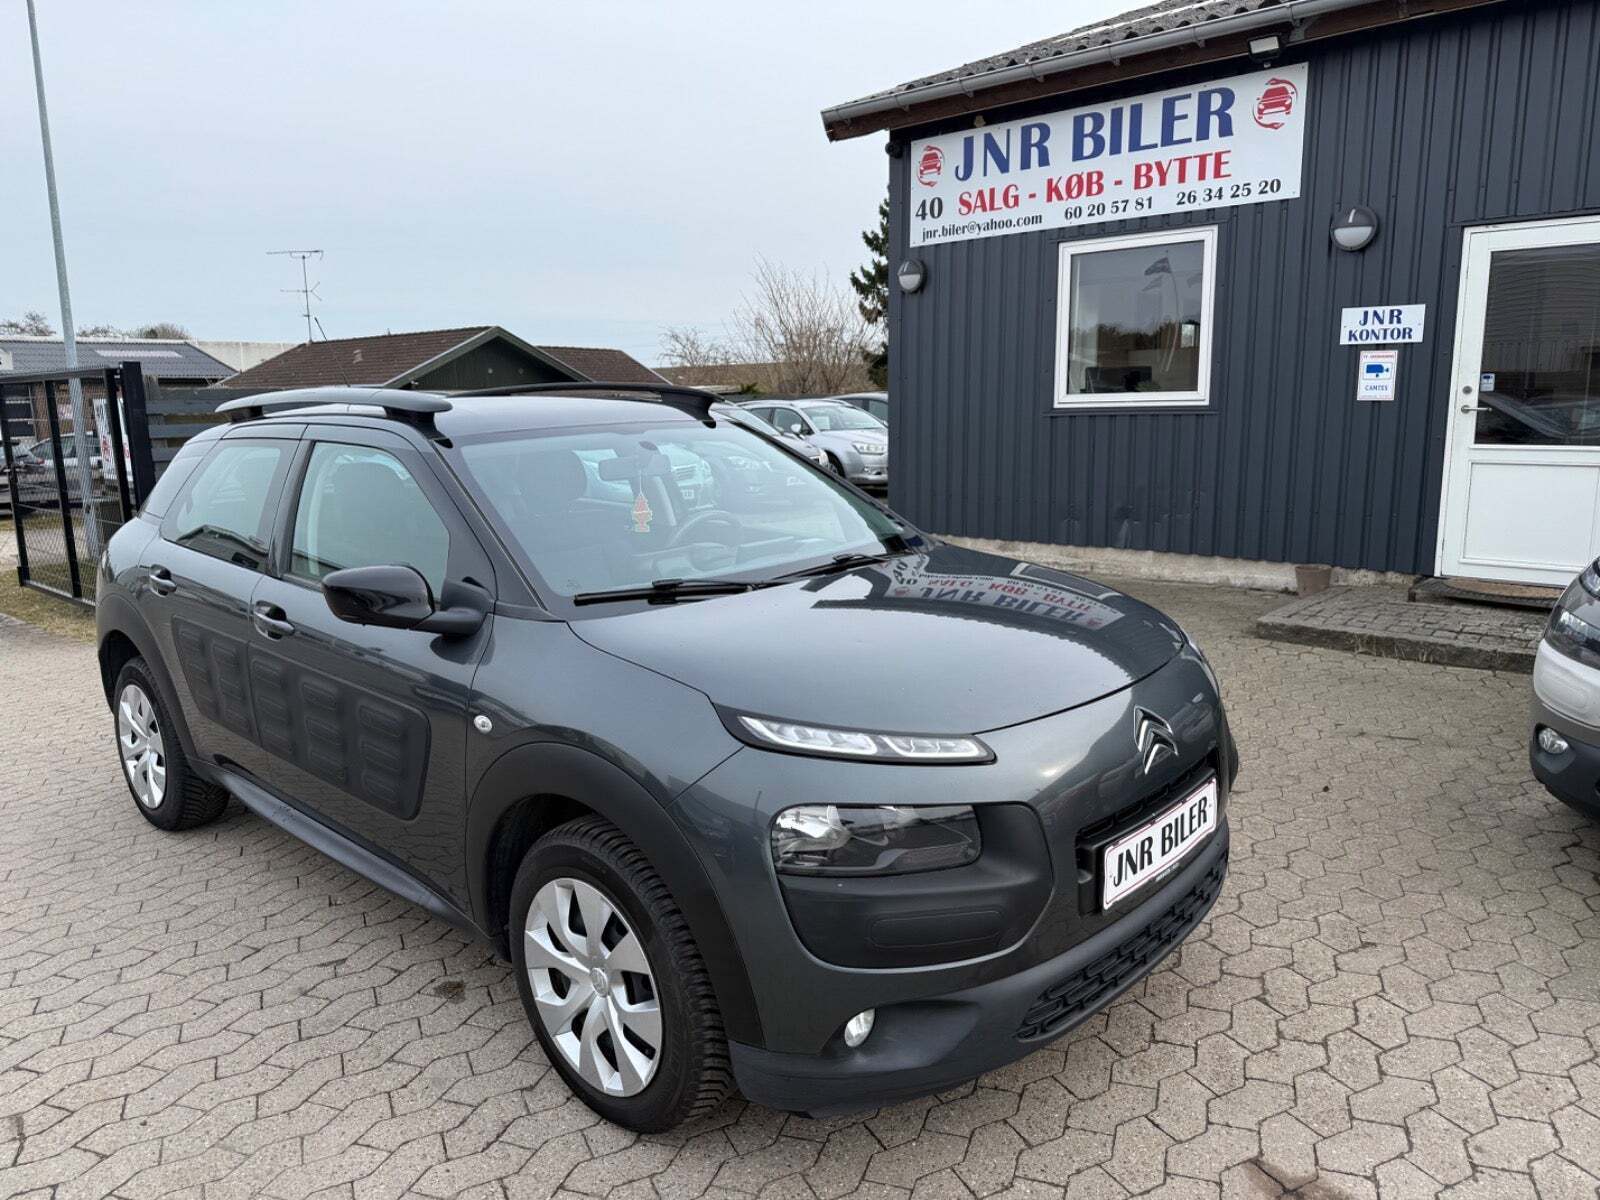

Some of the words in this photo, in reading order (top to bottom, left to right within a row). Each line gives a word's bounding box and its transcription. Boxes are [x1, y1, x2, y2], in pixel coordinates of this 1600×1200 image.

[955, 123, 1051, 181] JNR
[1072, 87, 1236, 162] BILER
[958, 184, 1020, 216] SALG
[1046, 170, 1104, 203] KØB
[1134, 150, 1232, 190] BYTTE
[1176, 190, 1197, 206] 26
[1203, 186, 1223, 202] 34
[1230, 182, 1252, 199] 25
[1258, 178, 1281, 195] 20
[915, 196, 944, 220] 40
[1064, 206, 1082, 220] 60
[1087, 202, 1106, 217] 20
[1110, 199, 1130, 214] 57
[1134, 196, 1153, 211] 81
[922, 214, 1043, 242] jnr.biler@yahoo.com
[1359, 308, 1403, 326] JNR
[1348, 327, 1413, 342] KONTOR
[1113, 836, 1153, 887] JNR
[1161, 796, 1208, 857] BILER
